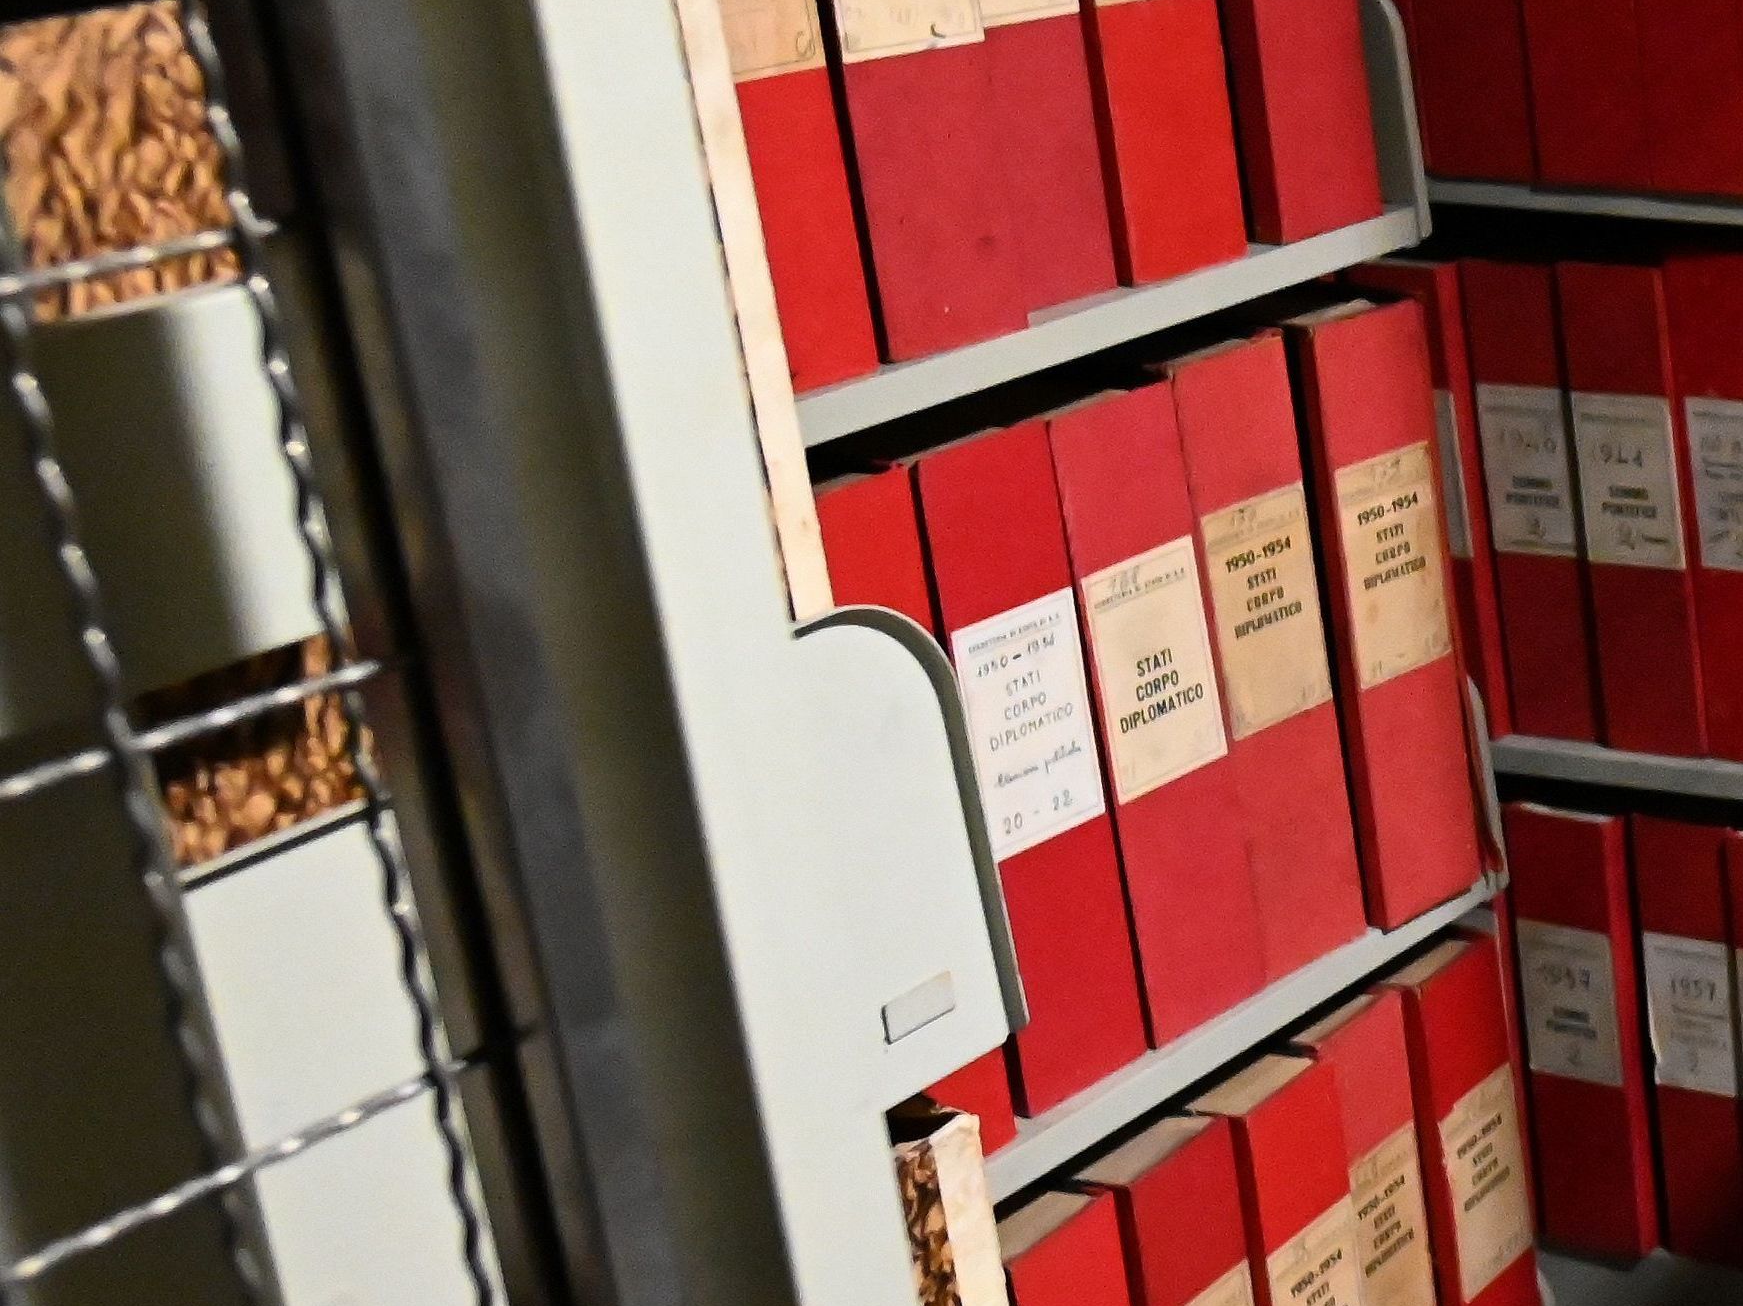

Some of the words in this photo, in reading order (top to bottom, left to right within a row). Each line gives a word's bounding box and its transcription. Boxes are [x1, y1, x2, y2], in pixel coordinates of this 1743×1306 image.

[1356, 491, 1419, 527] 1950-1954
[1375, 523, 1404, 544] STATI
[1225, 535, 1292, 574] 1950-1954
[1375, 541, 1411, 565] CORPO
[1246, 566, 1277, 591] STATI
[1363, 555, 1427, 591] DIPLOMATICO
[1246, 585, 1285, 613] CORPO
[1234, 600, 1303, 640] DIPLOMATICO
[1136, 647, 1174, 678] STATI
[1005, 669, 1042, 697] STATI
[1135, 669, 1180, 702] CORPO
[1003, 691, 1048, 722] CORPO
[1119, 682, 1204, 735] DIPLOMATICO
[989, 702, 1074, 752] DIPLOMATICO
